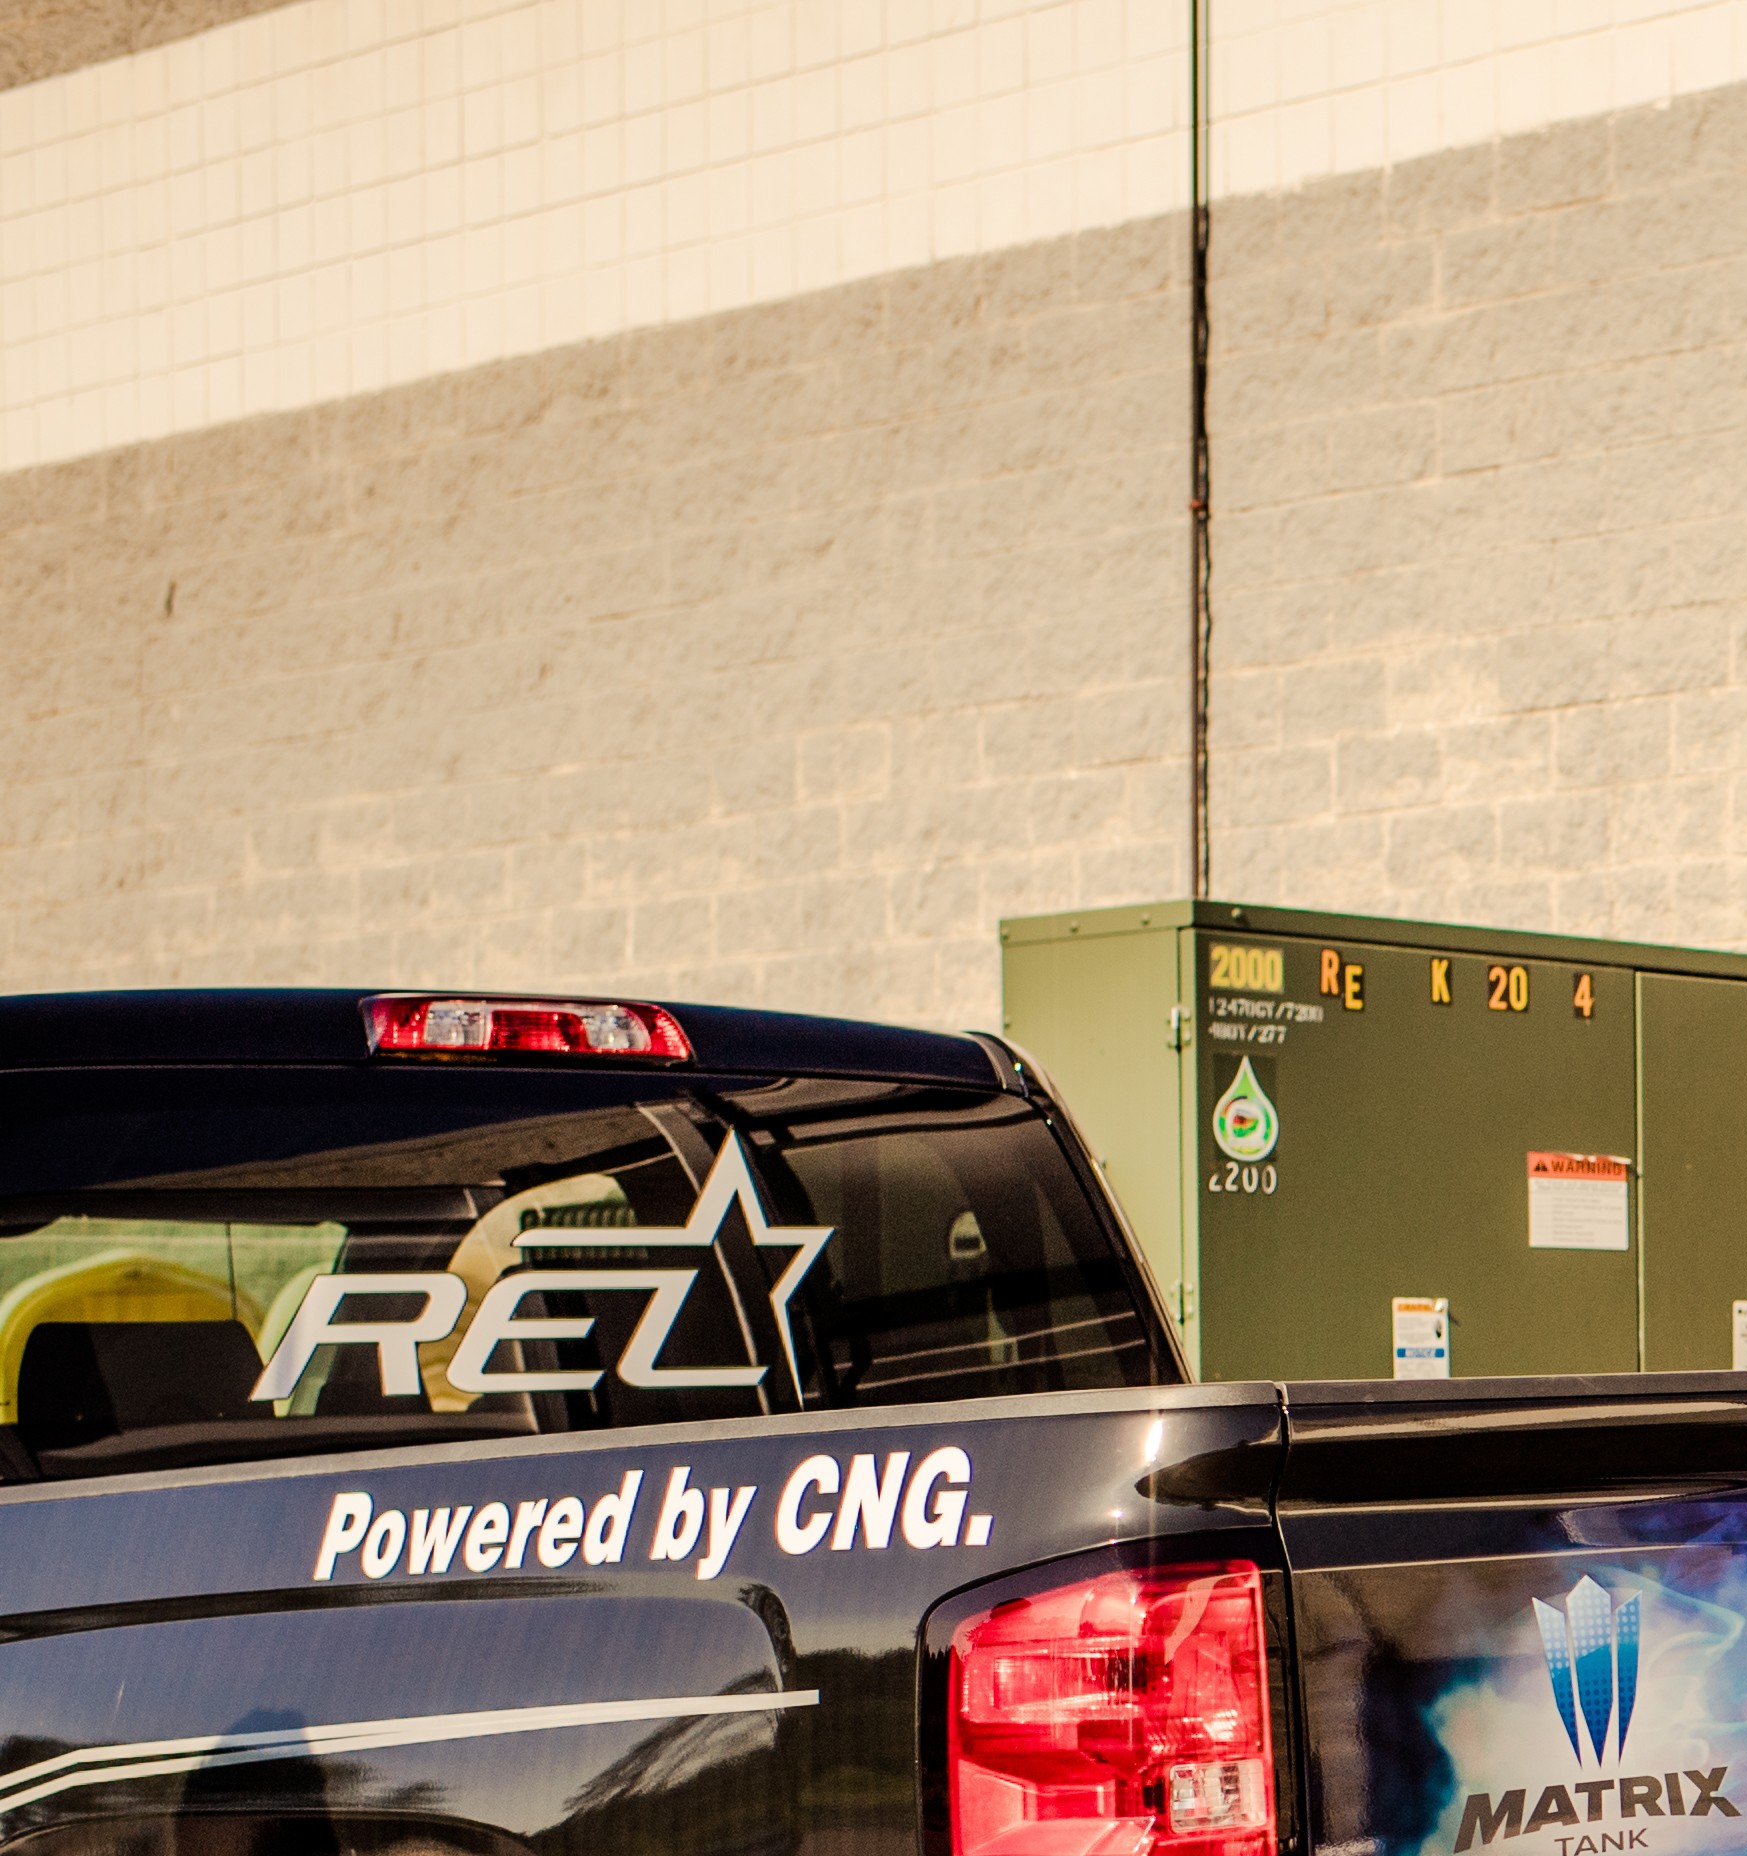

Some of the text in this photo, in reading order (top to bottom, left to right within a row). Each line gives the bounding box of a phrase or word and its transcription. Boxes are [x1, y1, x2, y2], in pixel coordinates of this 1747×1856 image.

[1210, 945, 1283, 991] 2000
[1431, 958, 1450, 1003] K
[1488, 966, 1528, 1011] 20
[1573, 974, 1593, 1017] 4
[1551, 1160, 1622, 1176] WARNING
[315, 1446, 994, 1582] Powered by CNG.
[1453, 1766, 1742, 1855] MATRIX
